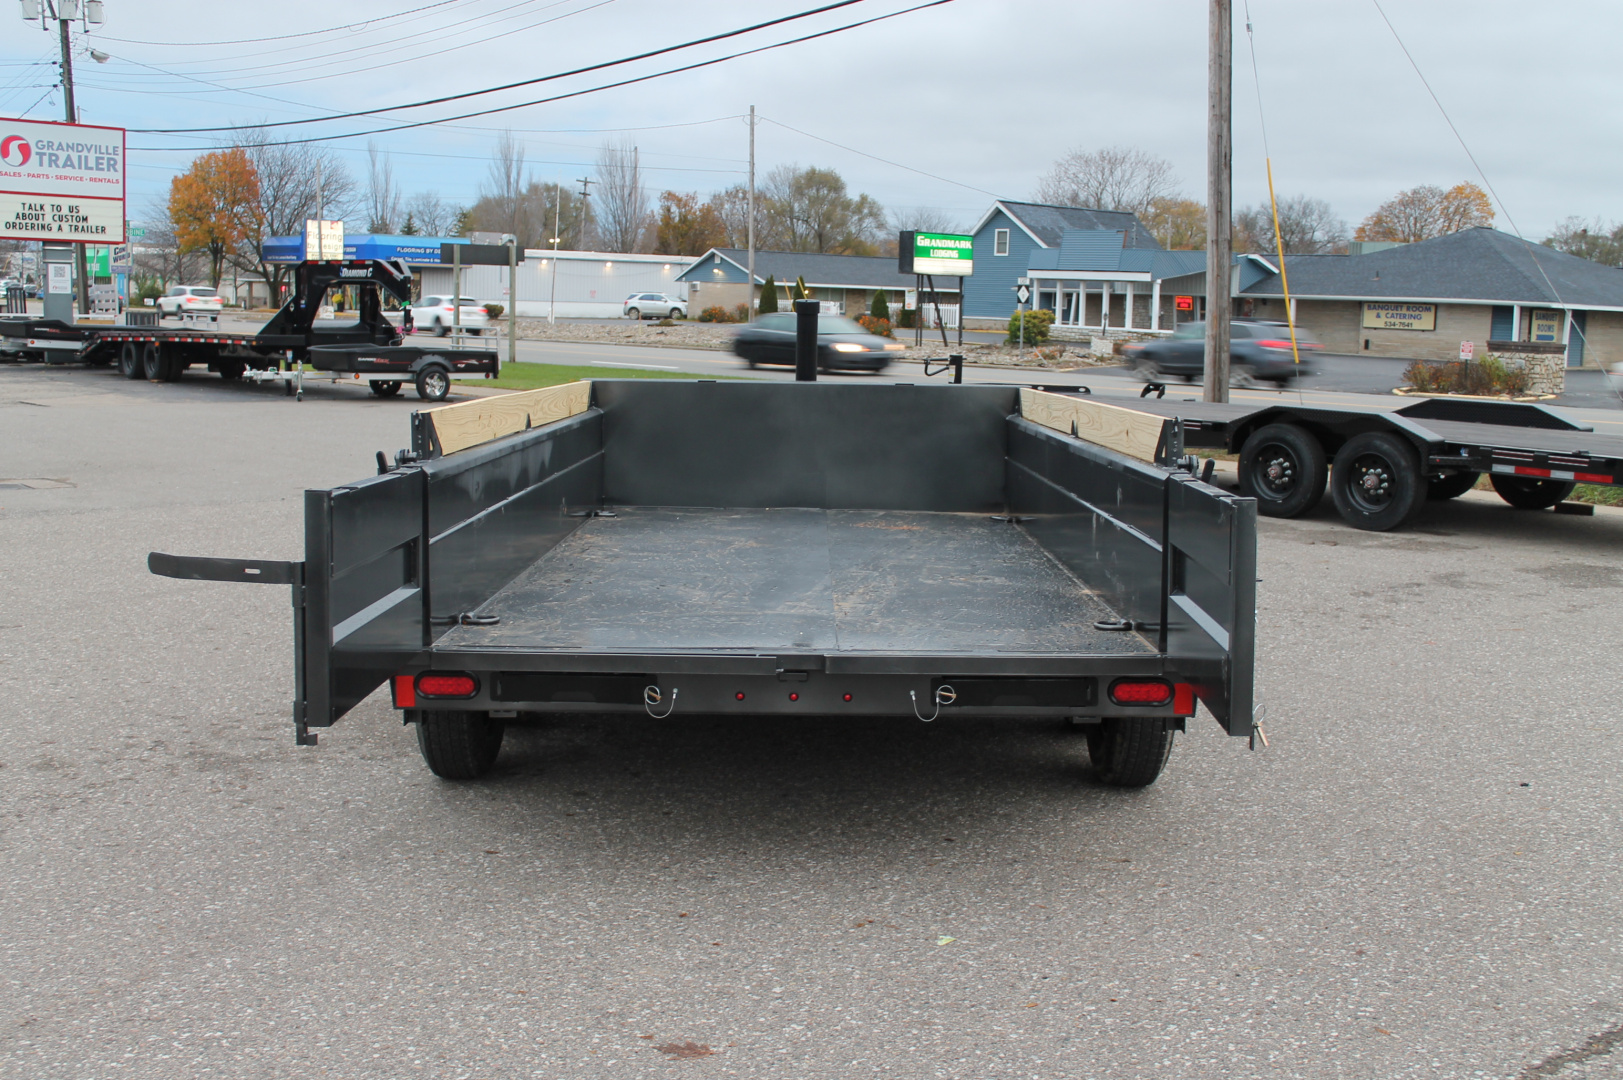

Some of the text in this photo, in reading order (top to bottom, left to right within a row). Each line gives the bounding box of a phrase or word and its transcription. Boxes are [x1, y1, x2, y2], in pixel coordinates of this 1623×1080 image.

[35, 140, 119, 156] GRANDVILLE
[35, 152, 119, 172] TRAILER
[27, 172, 50, 180] PARTS
[55, 174, 84, 182] SERVICE
[21, 202, 80, 214] TALK TO US
[15, 212, 89, 223] ABOUT CUSTOM
[5, 221, 107, 234] ORDERING A TRAILER
[917, 235, 973, 249] GRANDMARK
[930, 249, 959, 258] LODGING
[367, 267, 373, 277] C
[1367, 304, 1404, 312] BANQUET
[1385, 312, 1422, 320] CATERING
